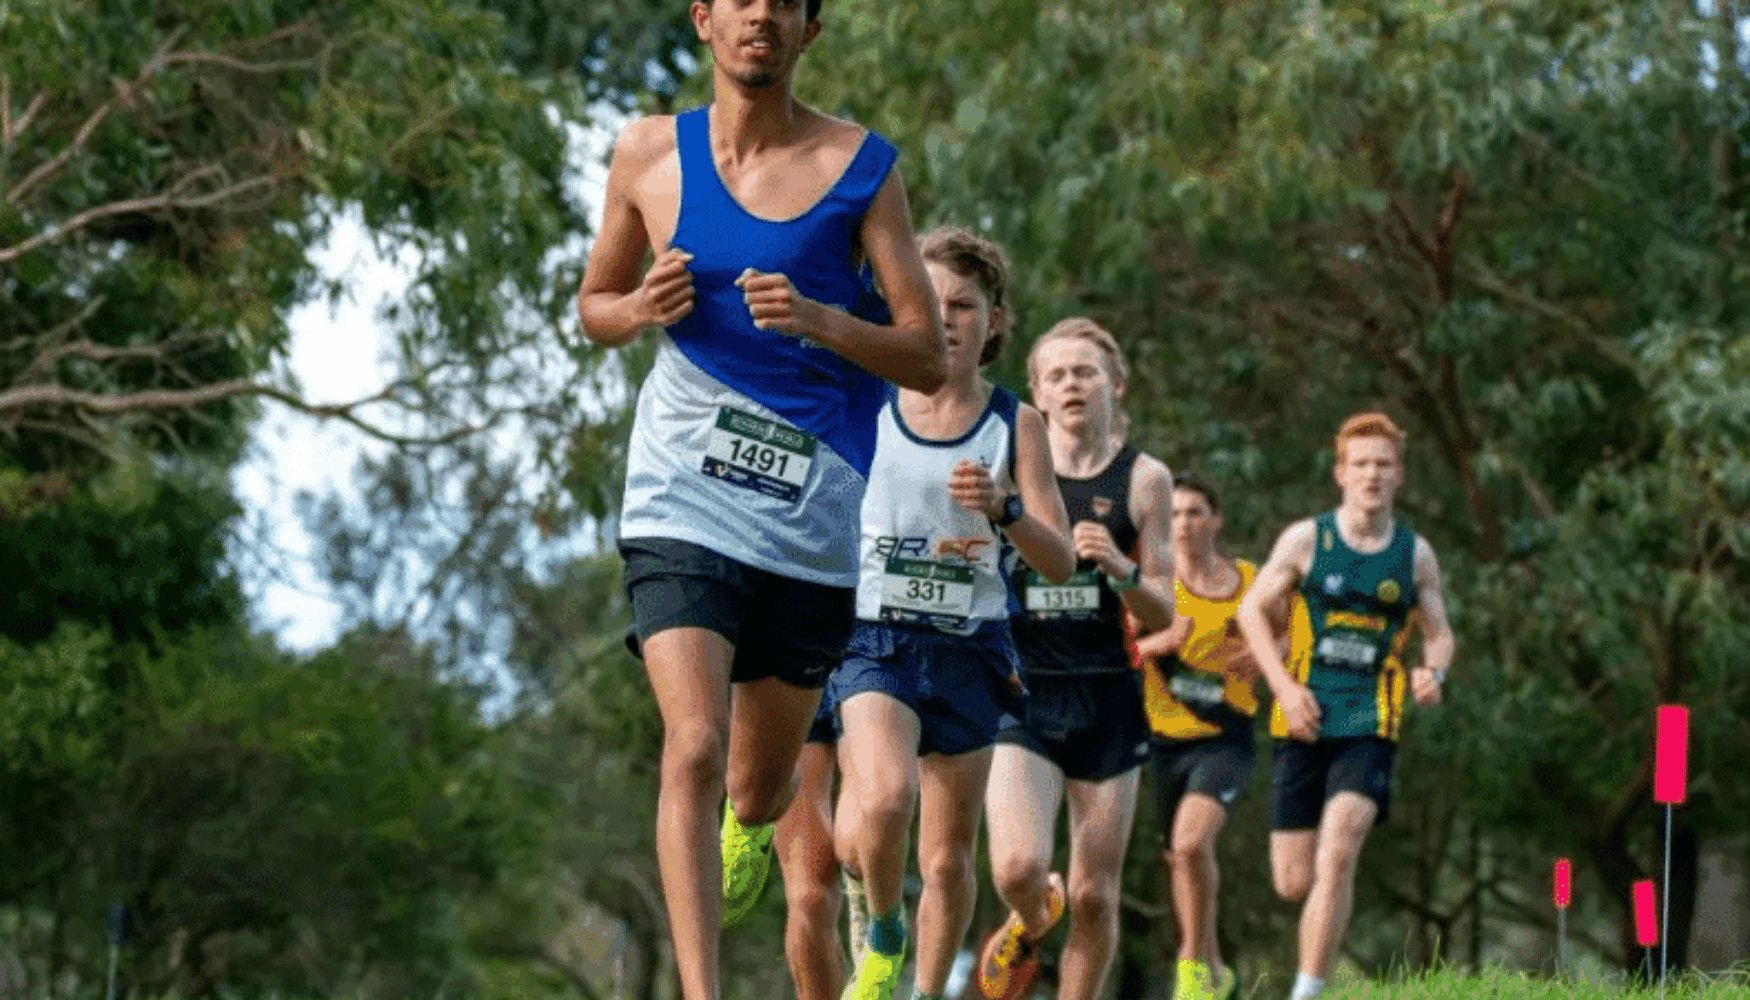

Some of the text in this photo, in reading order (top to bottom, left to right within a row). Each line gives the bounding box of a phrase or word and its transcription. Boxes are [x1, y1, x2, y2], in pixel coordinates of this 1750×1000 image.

[730, 439, 790, 477] 1491
[906, 579, 945, 602] 331
[1043, 590, 1086, 607] 1315
